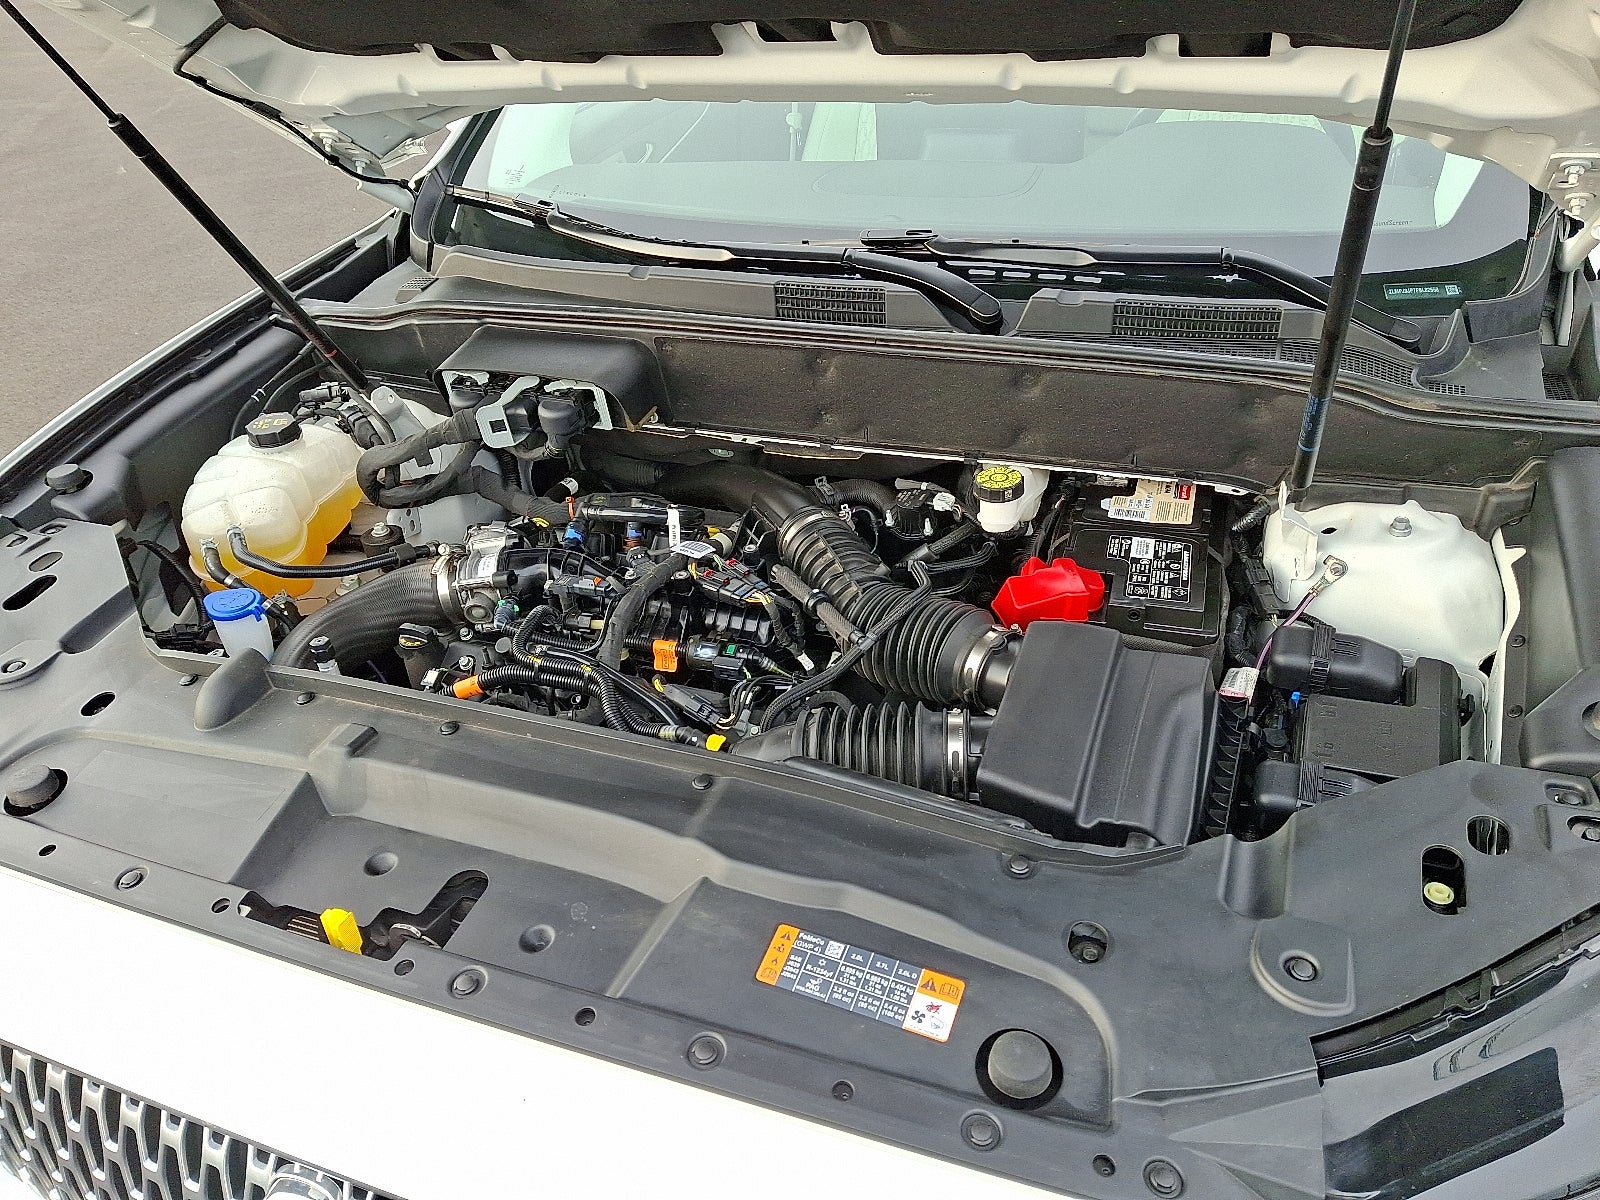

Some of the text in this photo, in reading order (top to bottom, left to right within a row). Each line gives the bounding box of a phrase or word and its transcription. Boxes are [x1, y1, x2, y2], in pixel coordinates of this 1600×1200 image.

[799, 932, 825, 946] FoMoCo
[794, 940, 822, 954] (GWP 4)
[850, 954, 864, 962] 2.0L
[875, 962, 890, 971] 2.7L
[805, 964, 834, 979] R-1234yf
[855, 971, 864, 979] kg
[898, 969, 911, 978] 2.0L
[906, 987, 914, 996] kg
